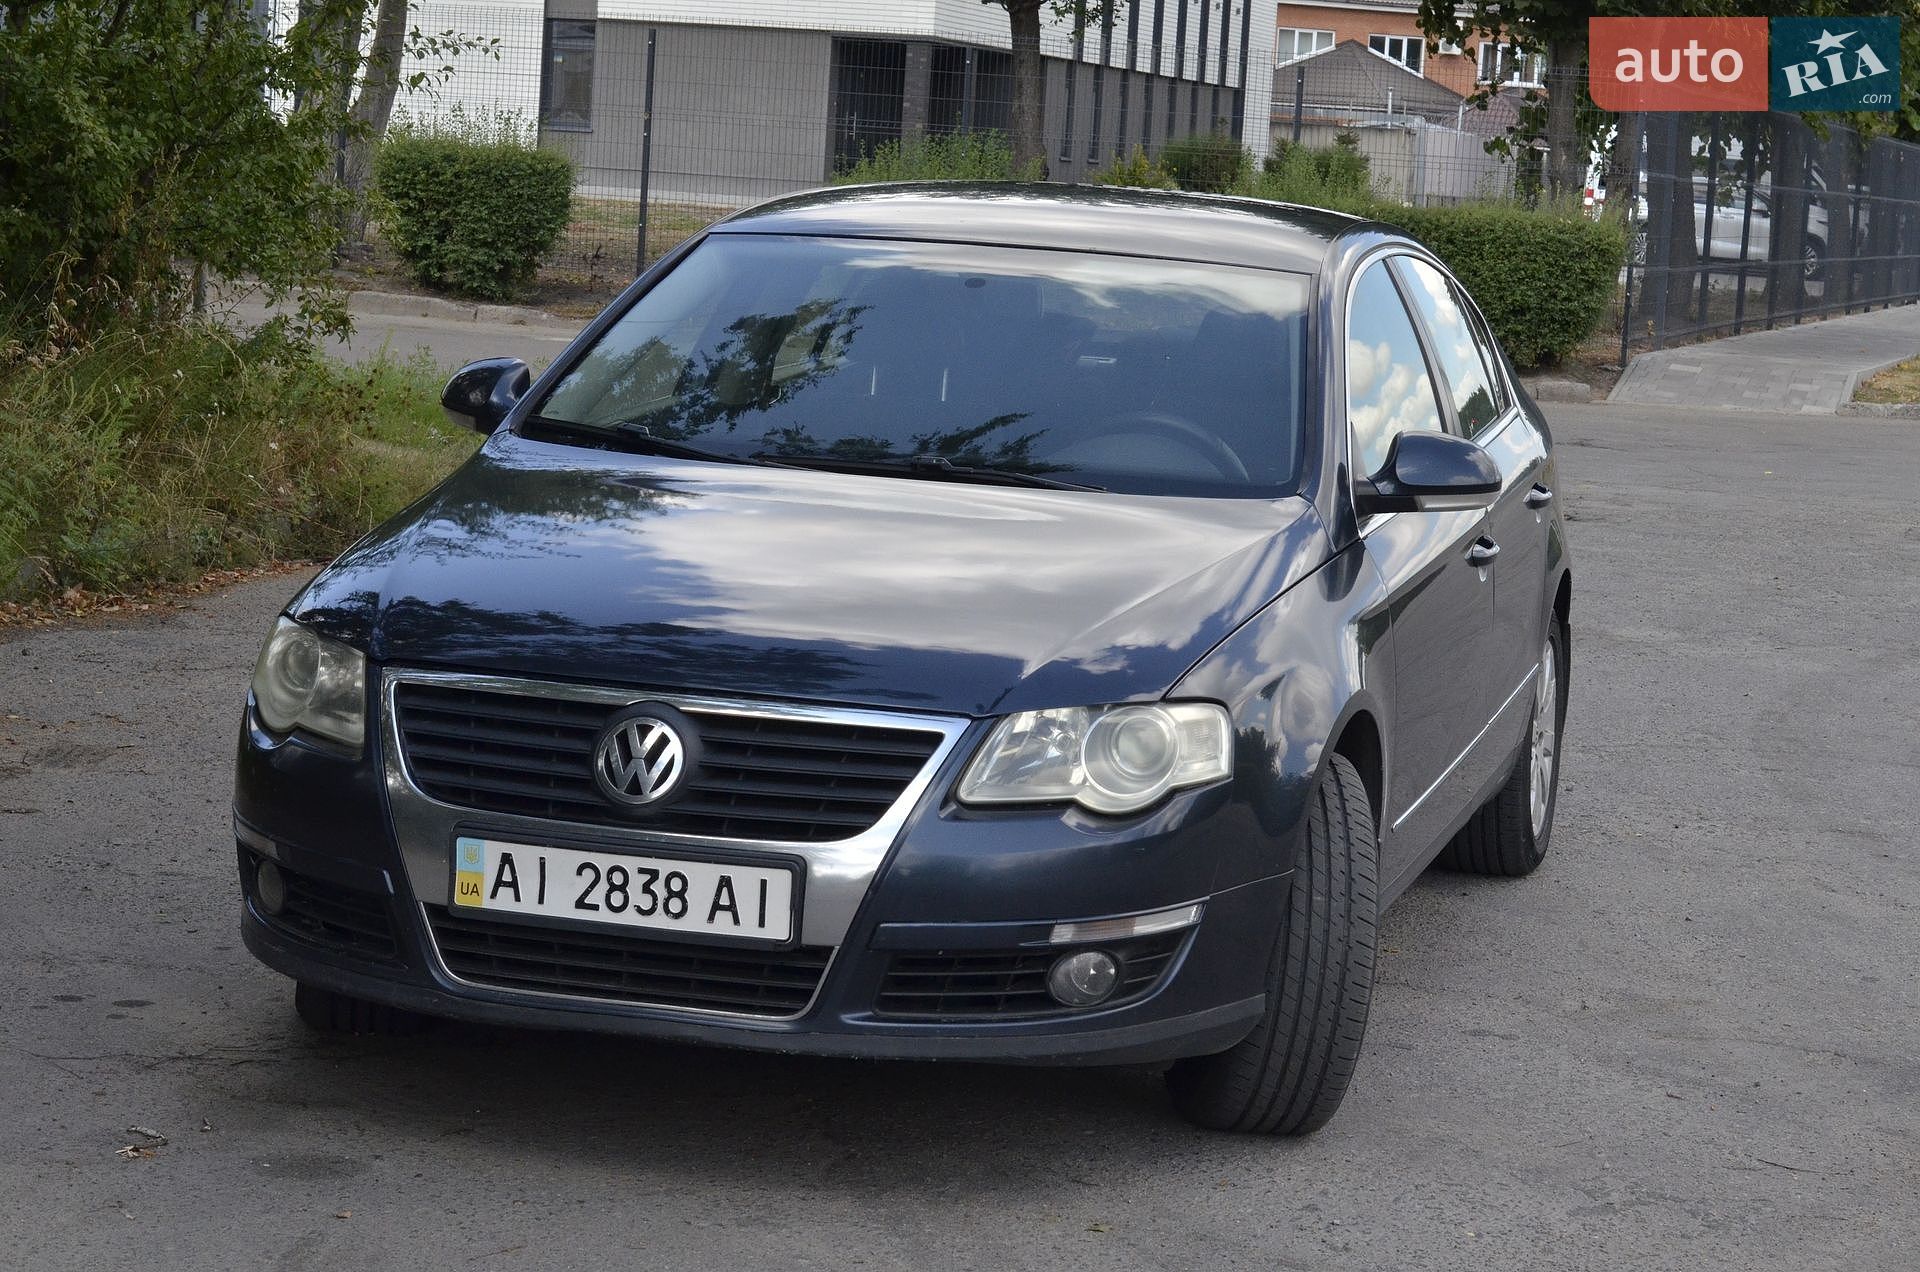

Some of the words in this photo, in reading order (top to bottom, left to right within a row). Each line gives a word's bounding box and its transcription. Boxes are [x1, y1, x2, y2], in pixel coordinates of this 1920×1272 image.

[460, 882, 480, 897] UA
[489, 852, 547, 905] AI
[574, 862, 689, 920] 2838
[706, 874, 768, 928] AI
